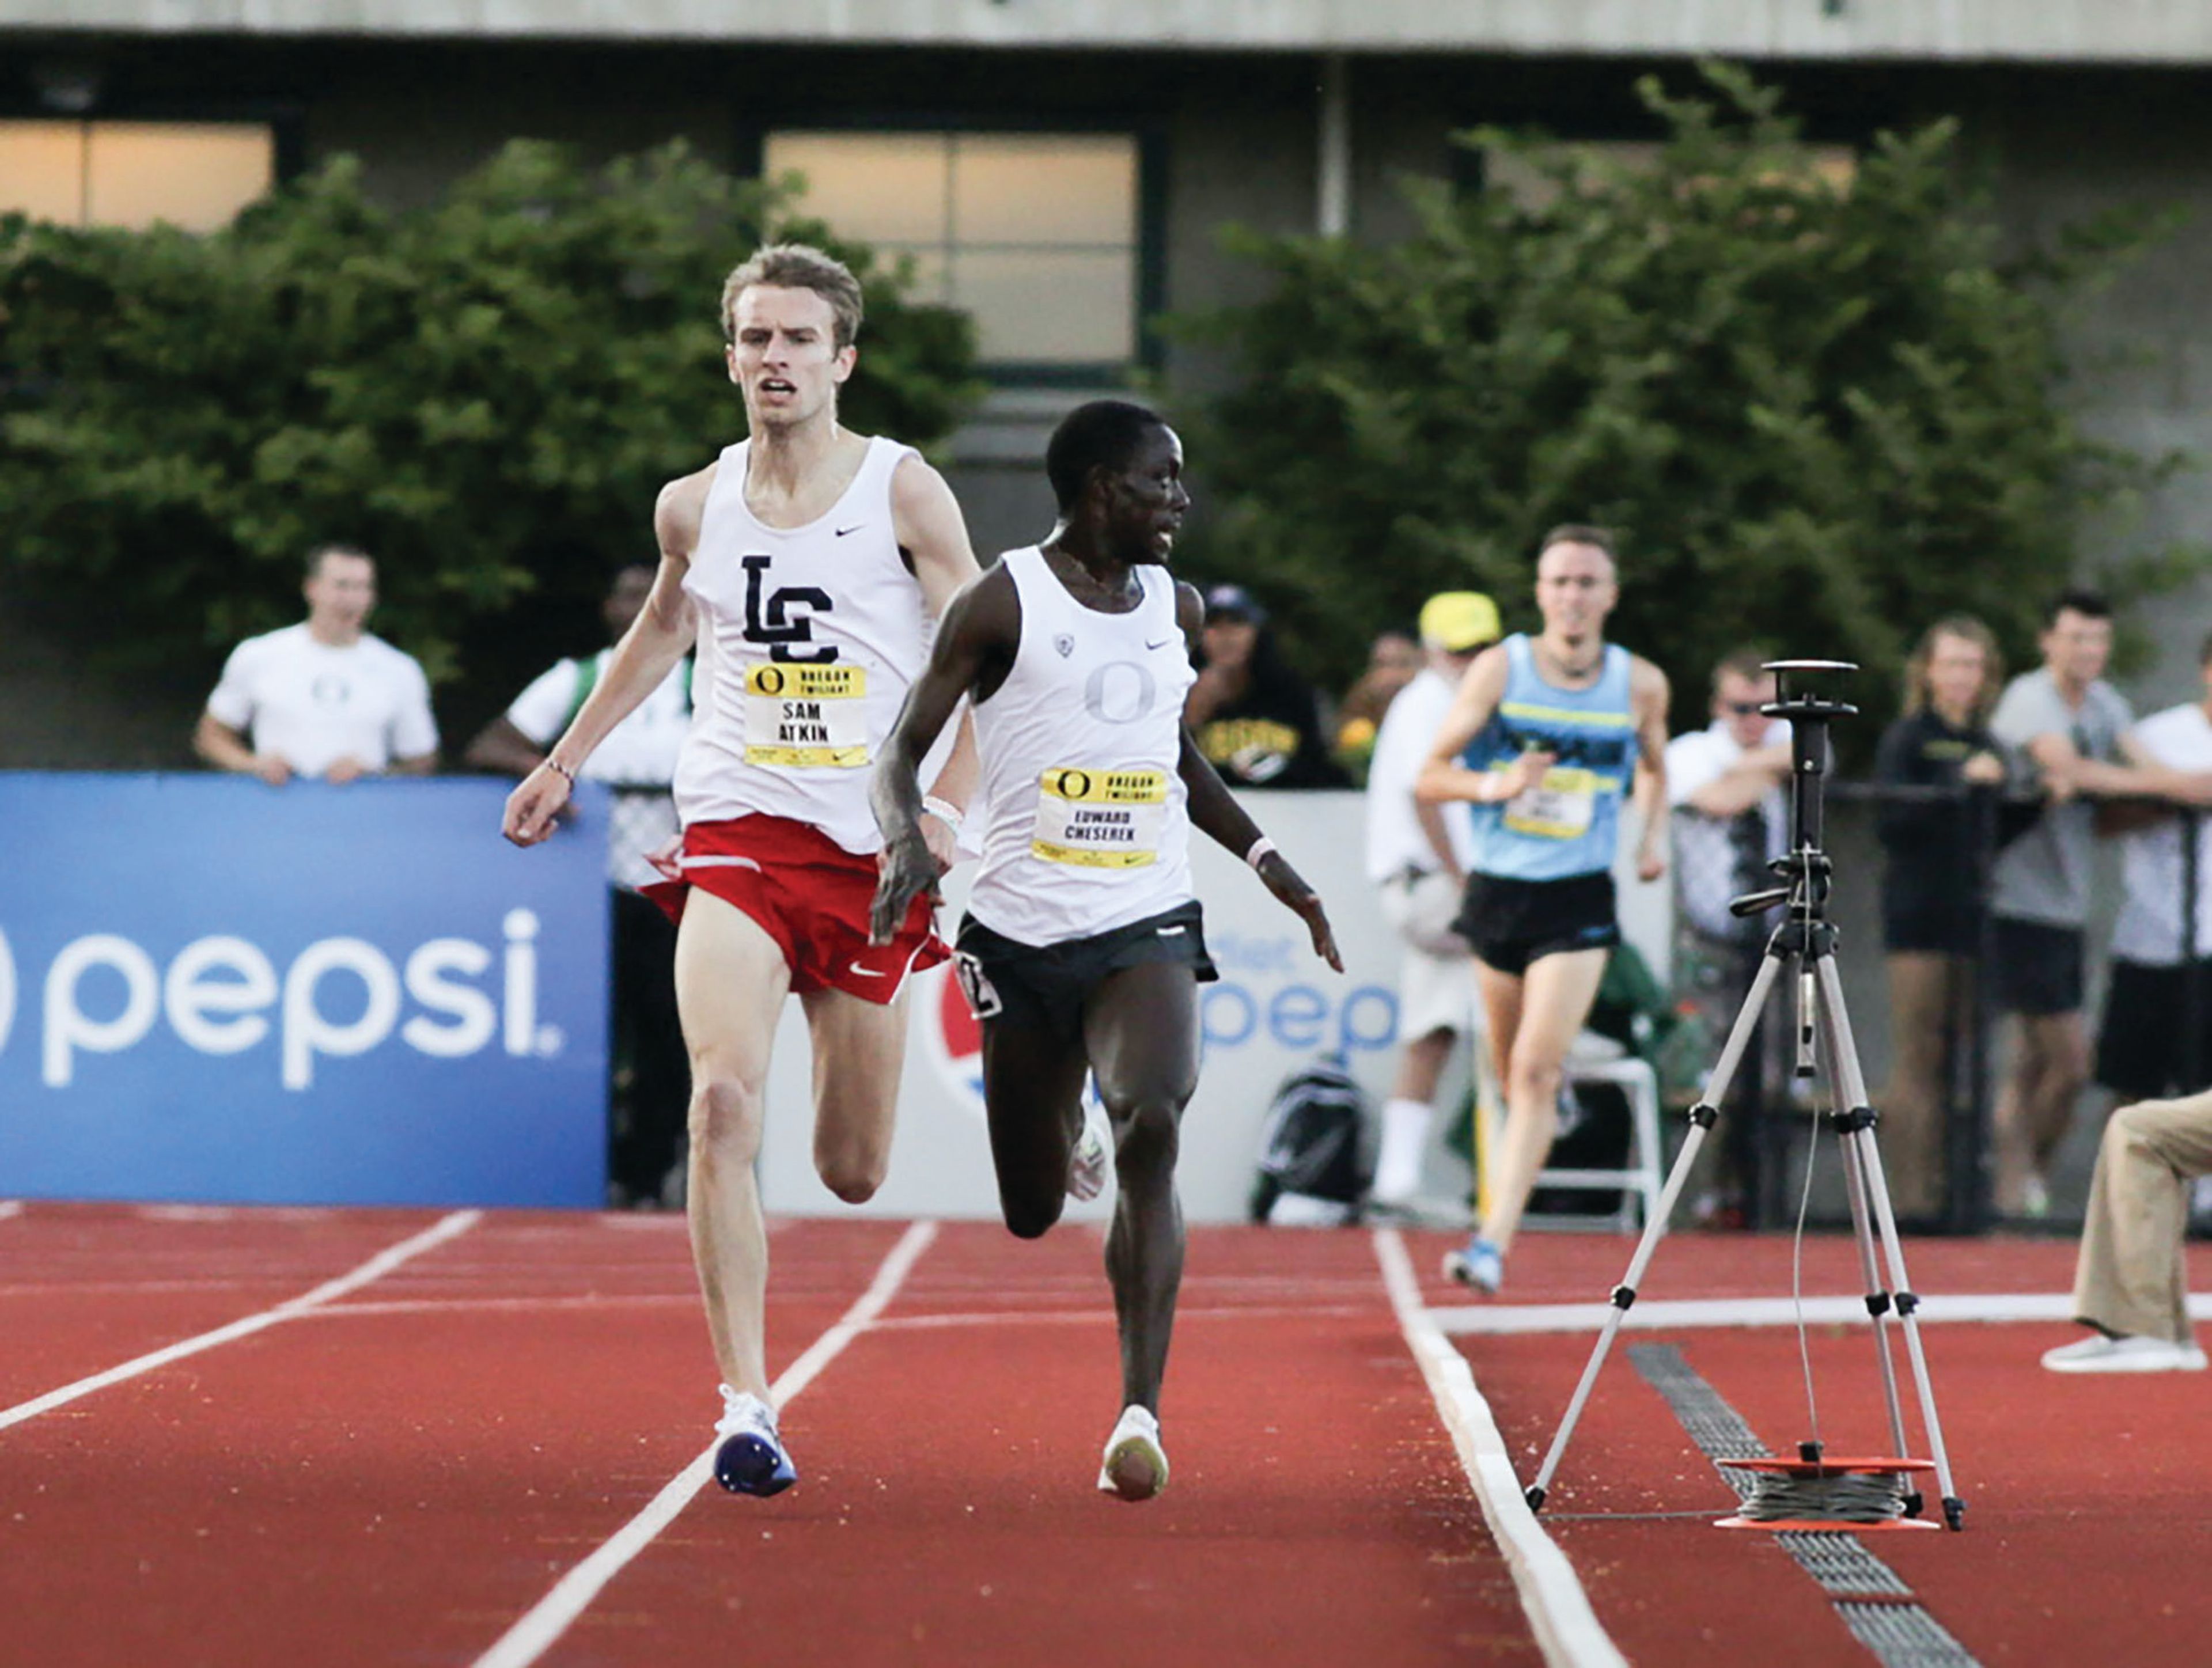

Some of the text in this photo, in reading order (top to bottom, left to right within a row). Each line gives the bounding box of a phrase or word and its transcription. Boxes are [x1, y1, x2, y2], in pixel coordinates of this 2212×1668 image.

[756, 666, 784, 695] O
[1085, 661, 1156, 724] O
[783, 702, 820, 719] SAM
[779, 724, 828, 741] ATKIN
[1058, 770, 1090, 799] O
[1075, 811, 1130, 824] EDWARD
[1065, 825, 1134, 841] CHESEREK
[43, 907, 539, 1091] pepsi
